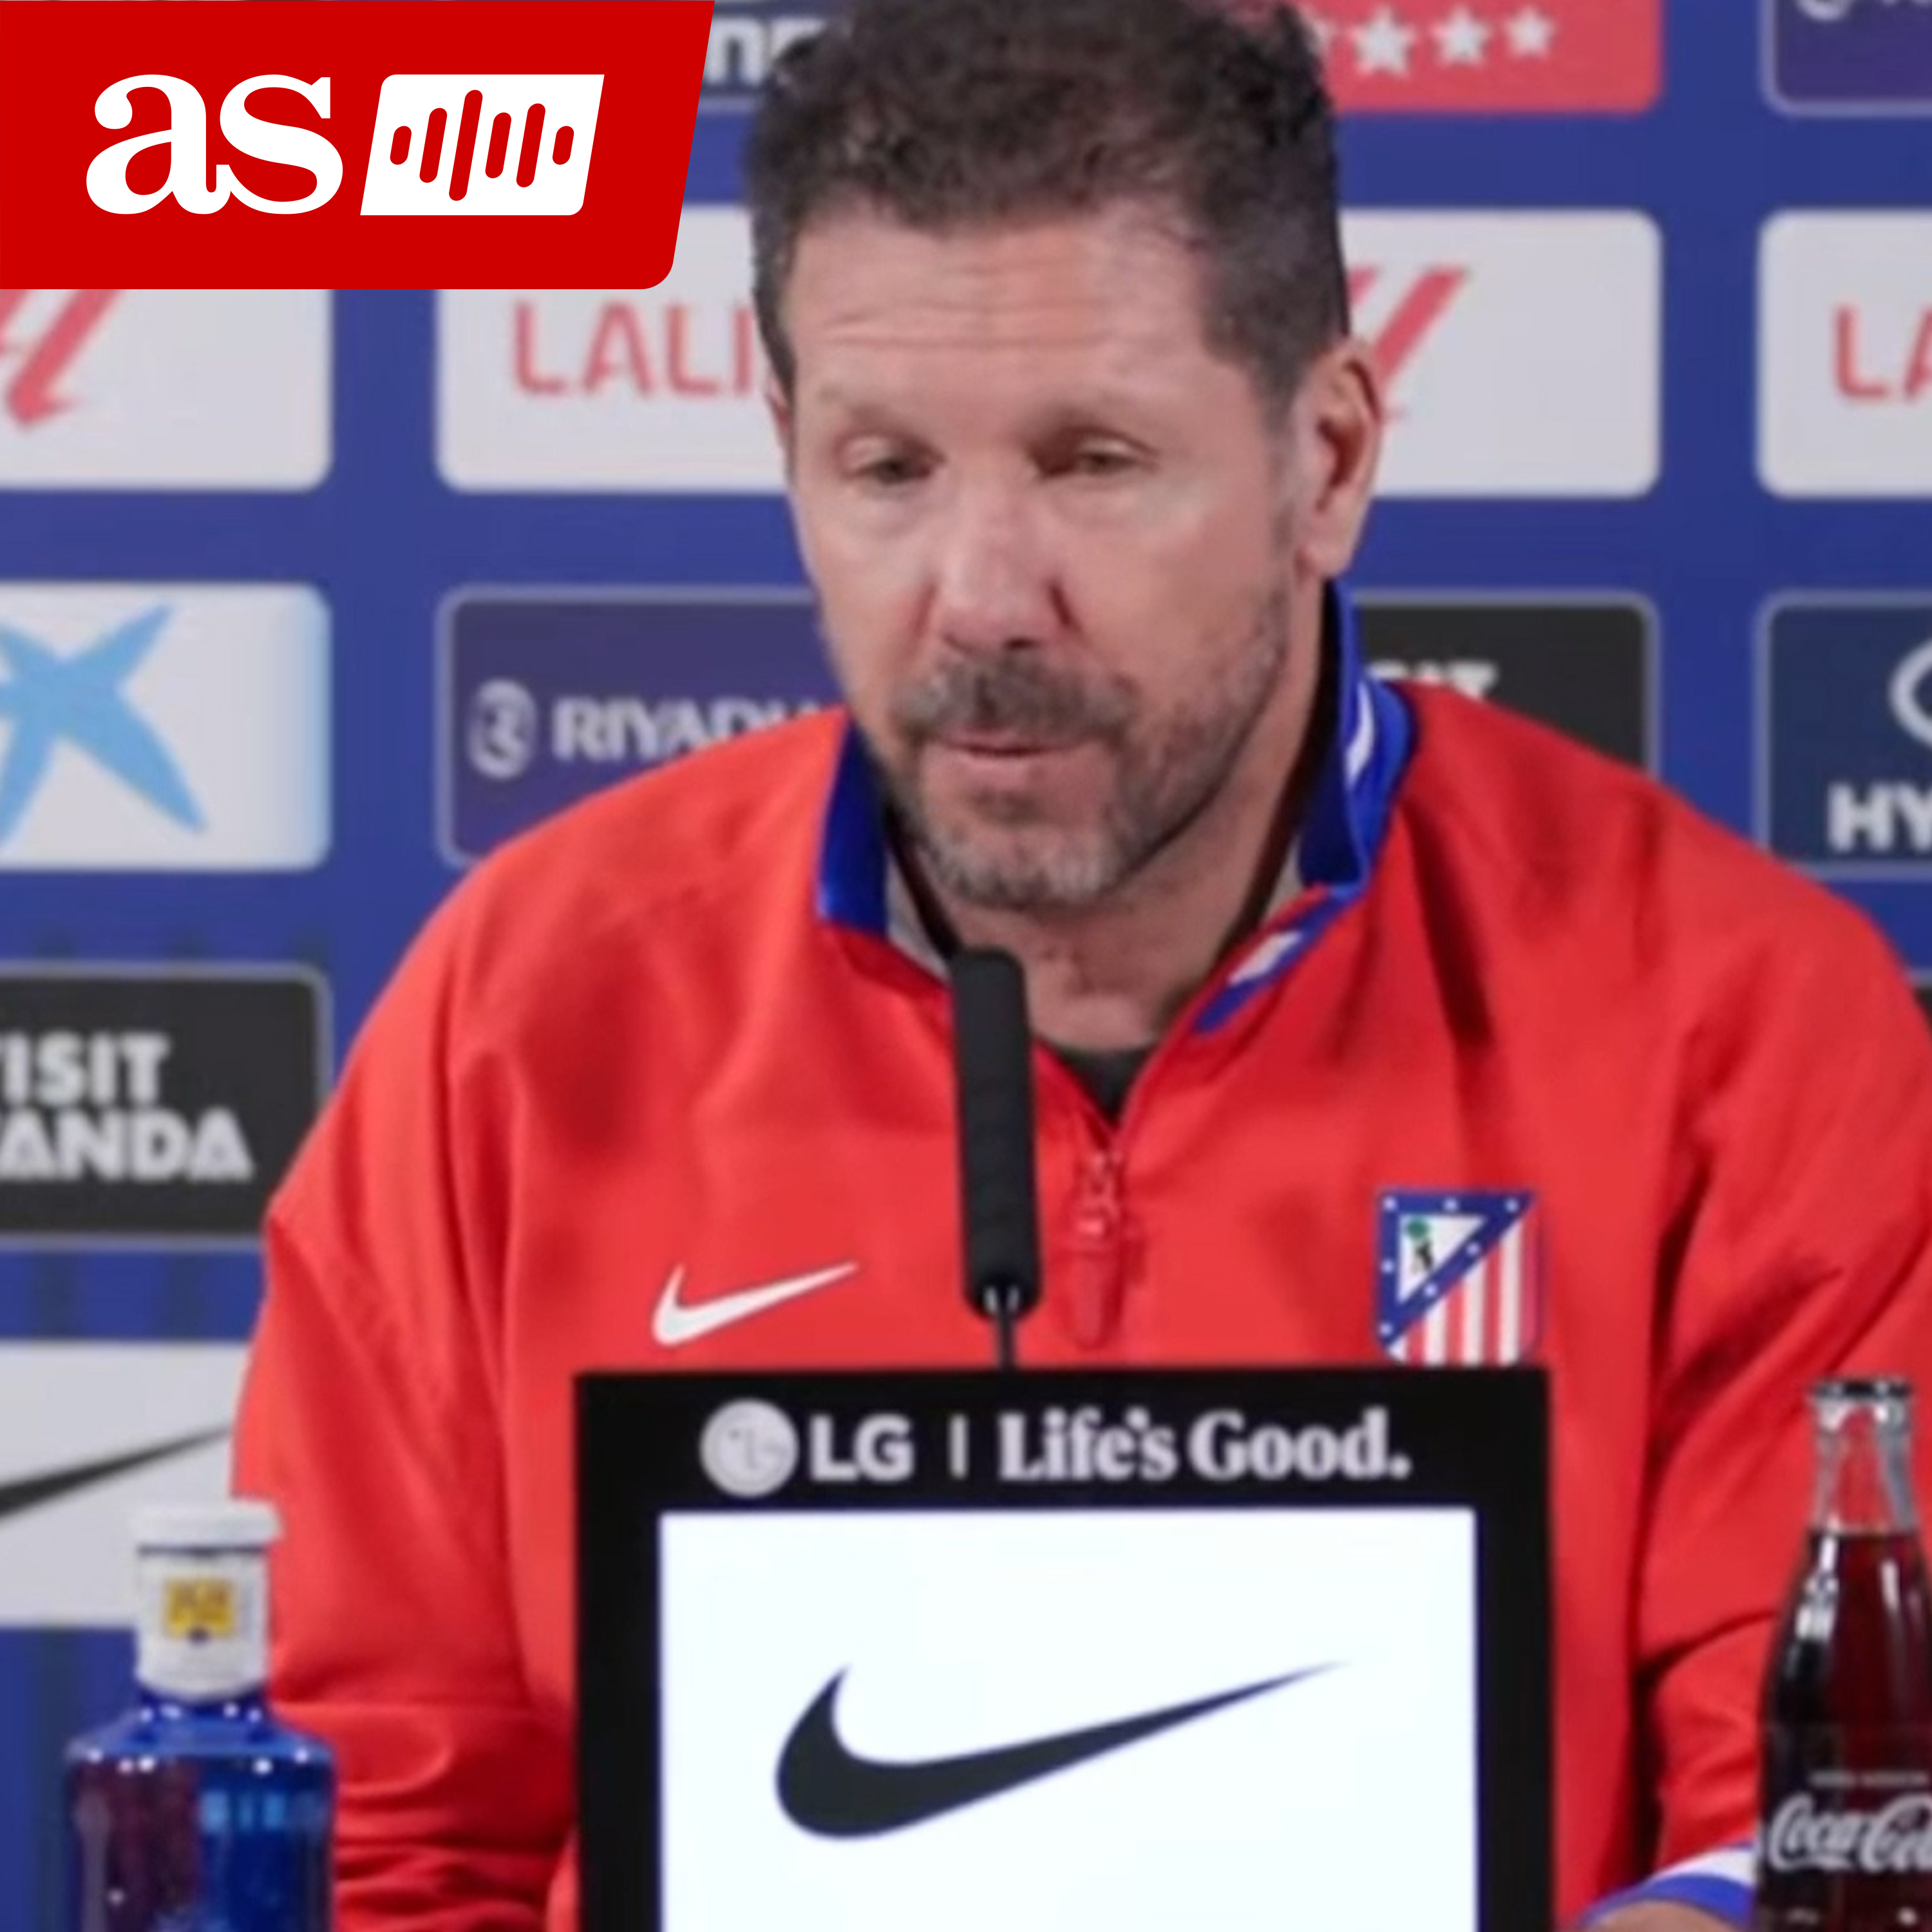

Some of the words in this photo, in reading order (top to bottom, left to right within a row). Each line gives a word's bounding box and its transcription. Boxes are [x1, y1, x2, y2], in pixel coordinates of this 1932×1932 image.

[0, 1032, 169, 1104] ISIT
[811, 1414, 913, 1481] LG
[999, 1407, 1177, 1481] Life's
[1189, 1407, 1410, 1479] Good.
